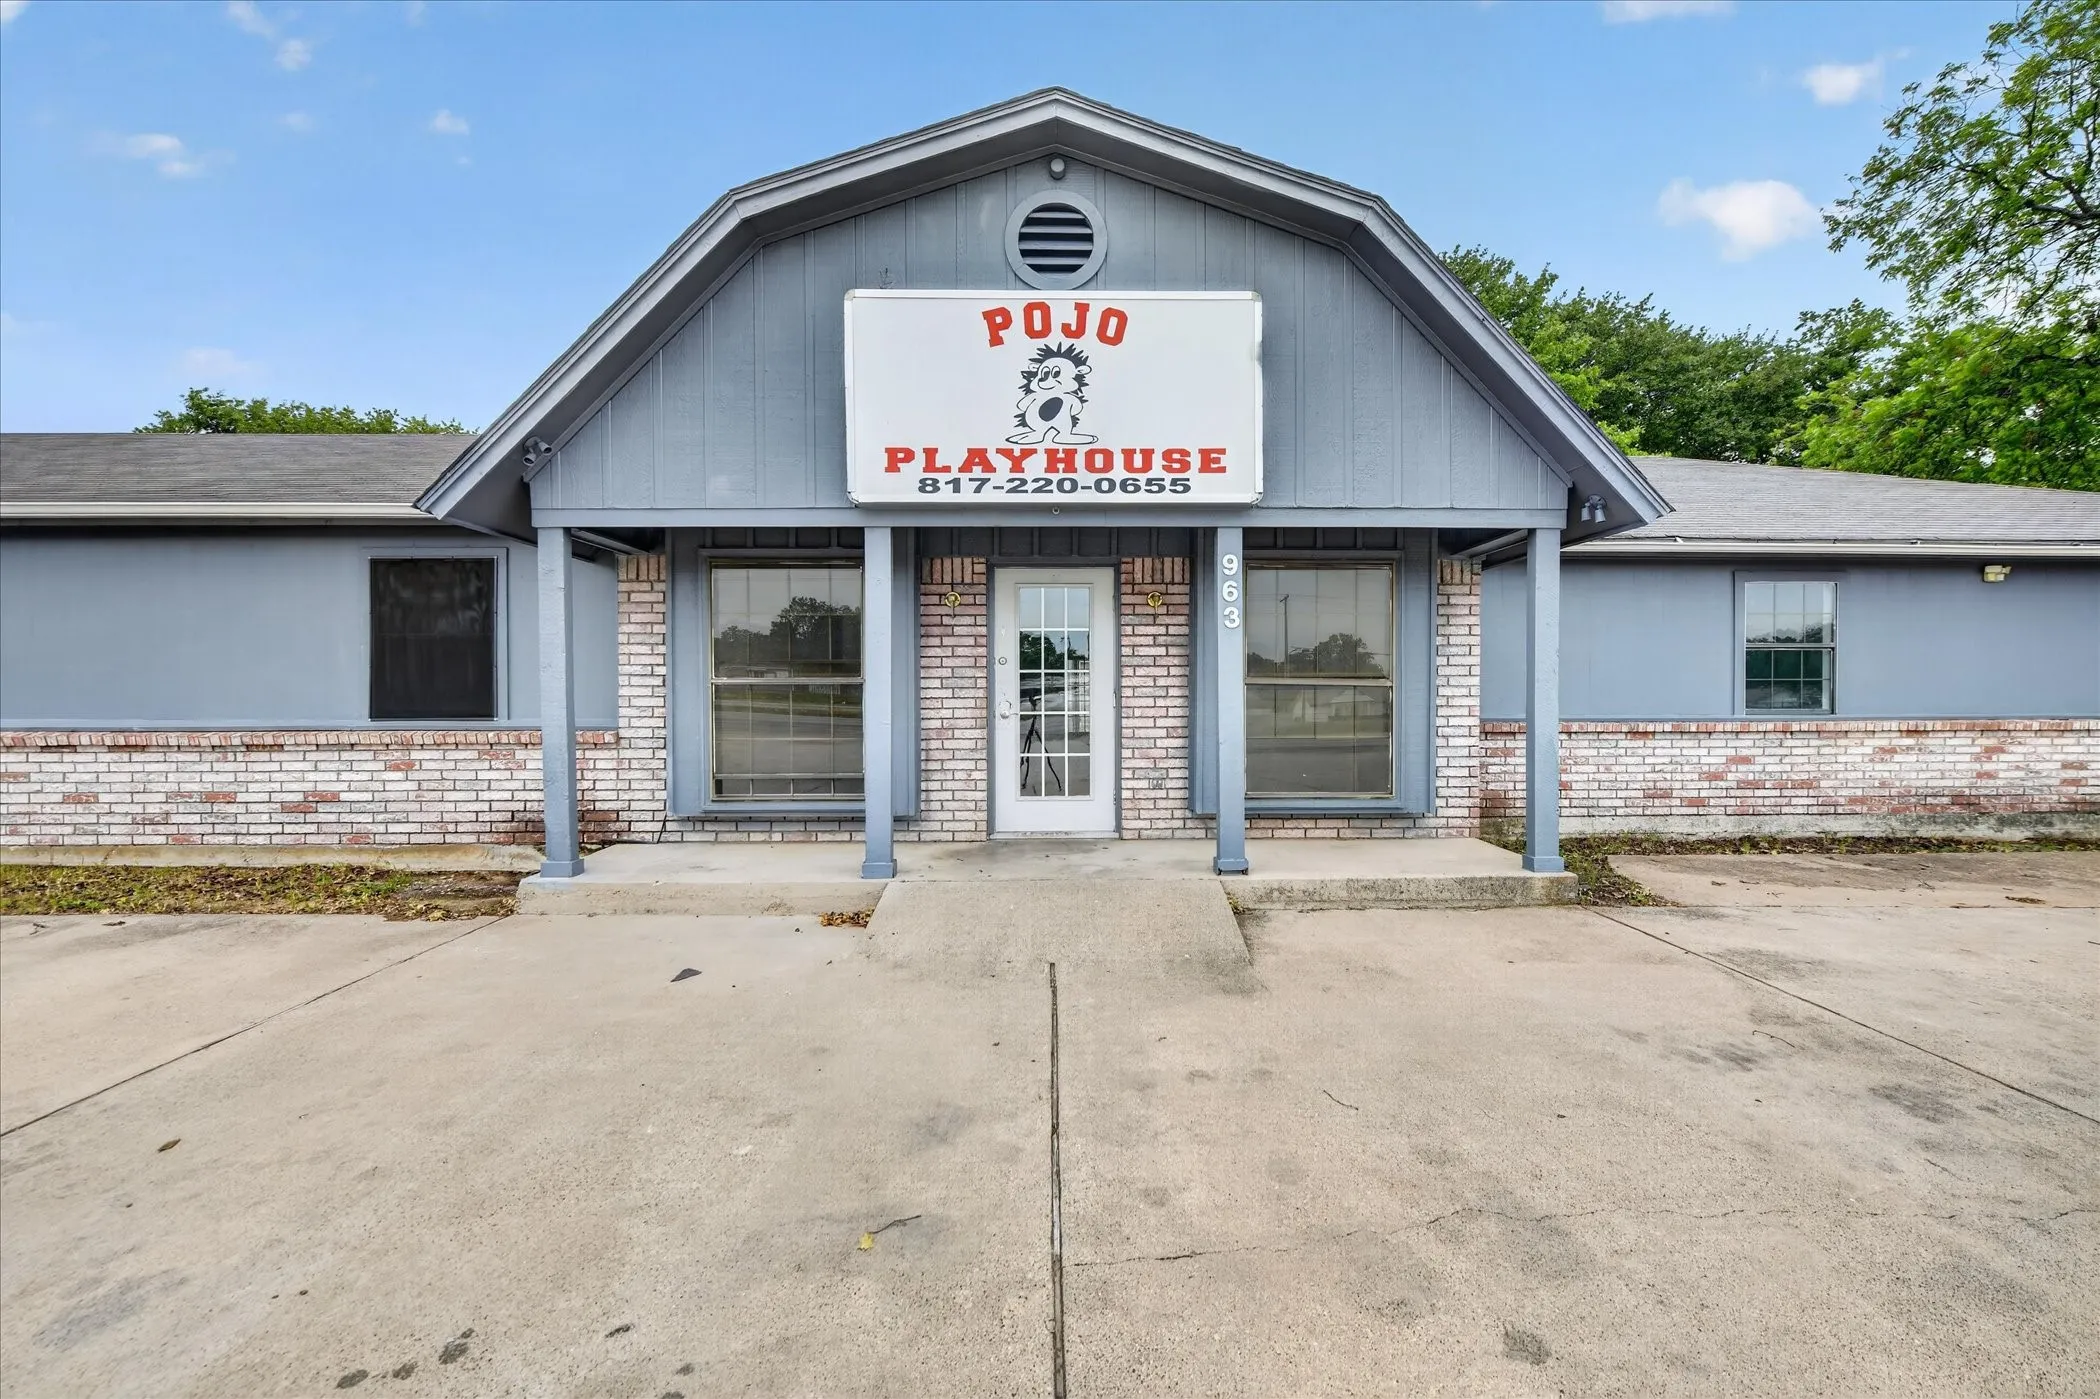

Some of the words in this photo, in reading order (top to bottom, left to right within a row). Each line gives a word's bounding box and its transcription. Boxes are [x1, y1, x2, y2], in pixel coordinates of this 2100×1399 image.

[982, 301, 1128, 347] POJO
[885, 447, 1226, 474] PLAYHOUSE
[918, 477, 1192, 494] 817-220-0655
[1222, 554, 1240, 629] 963
